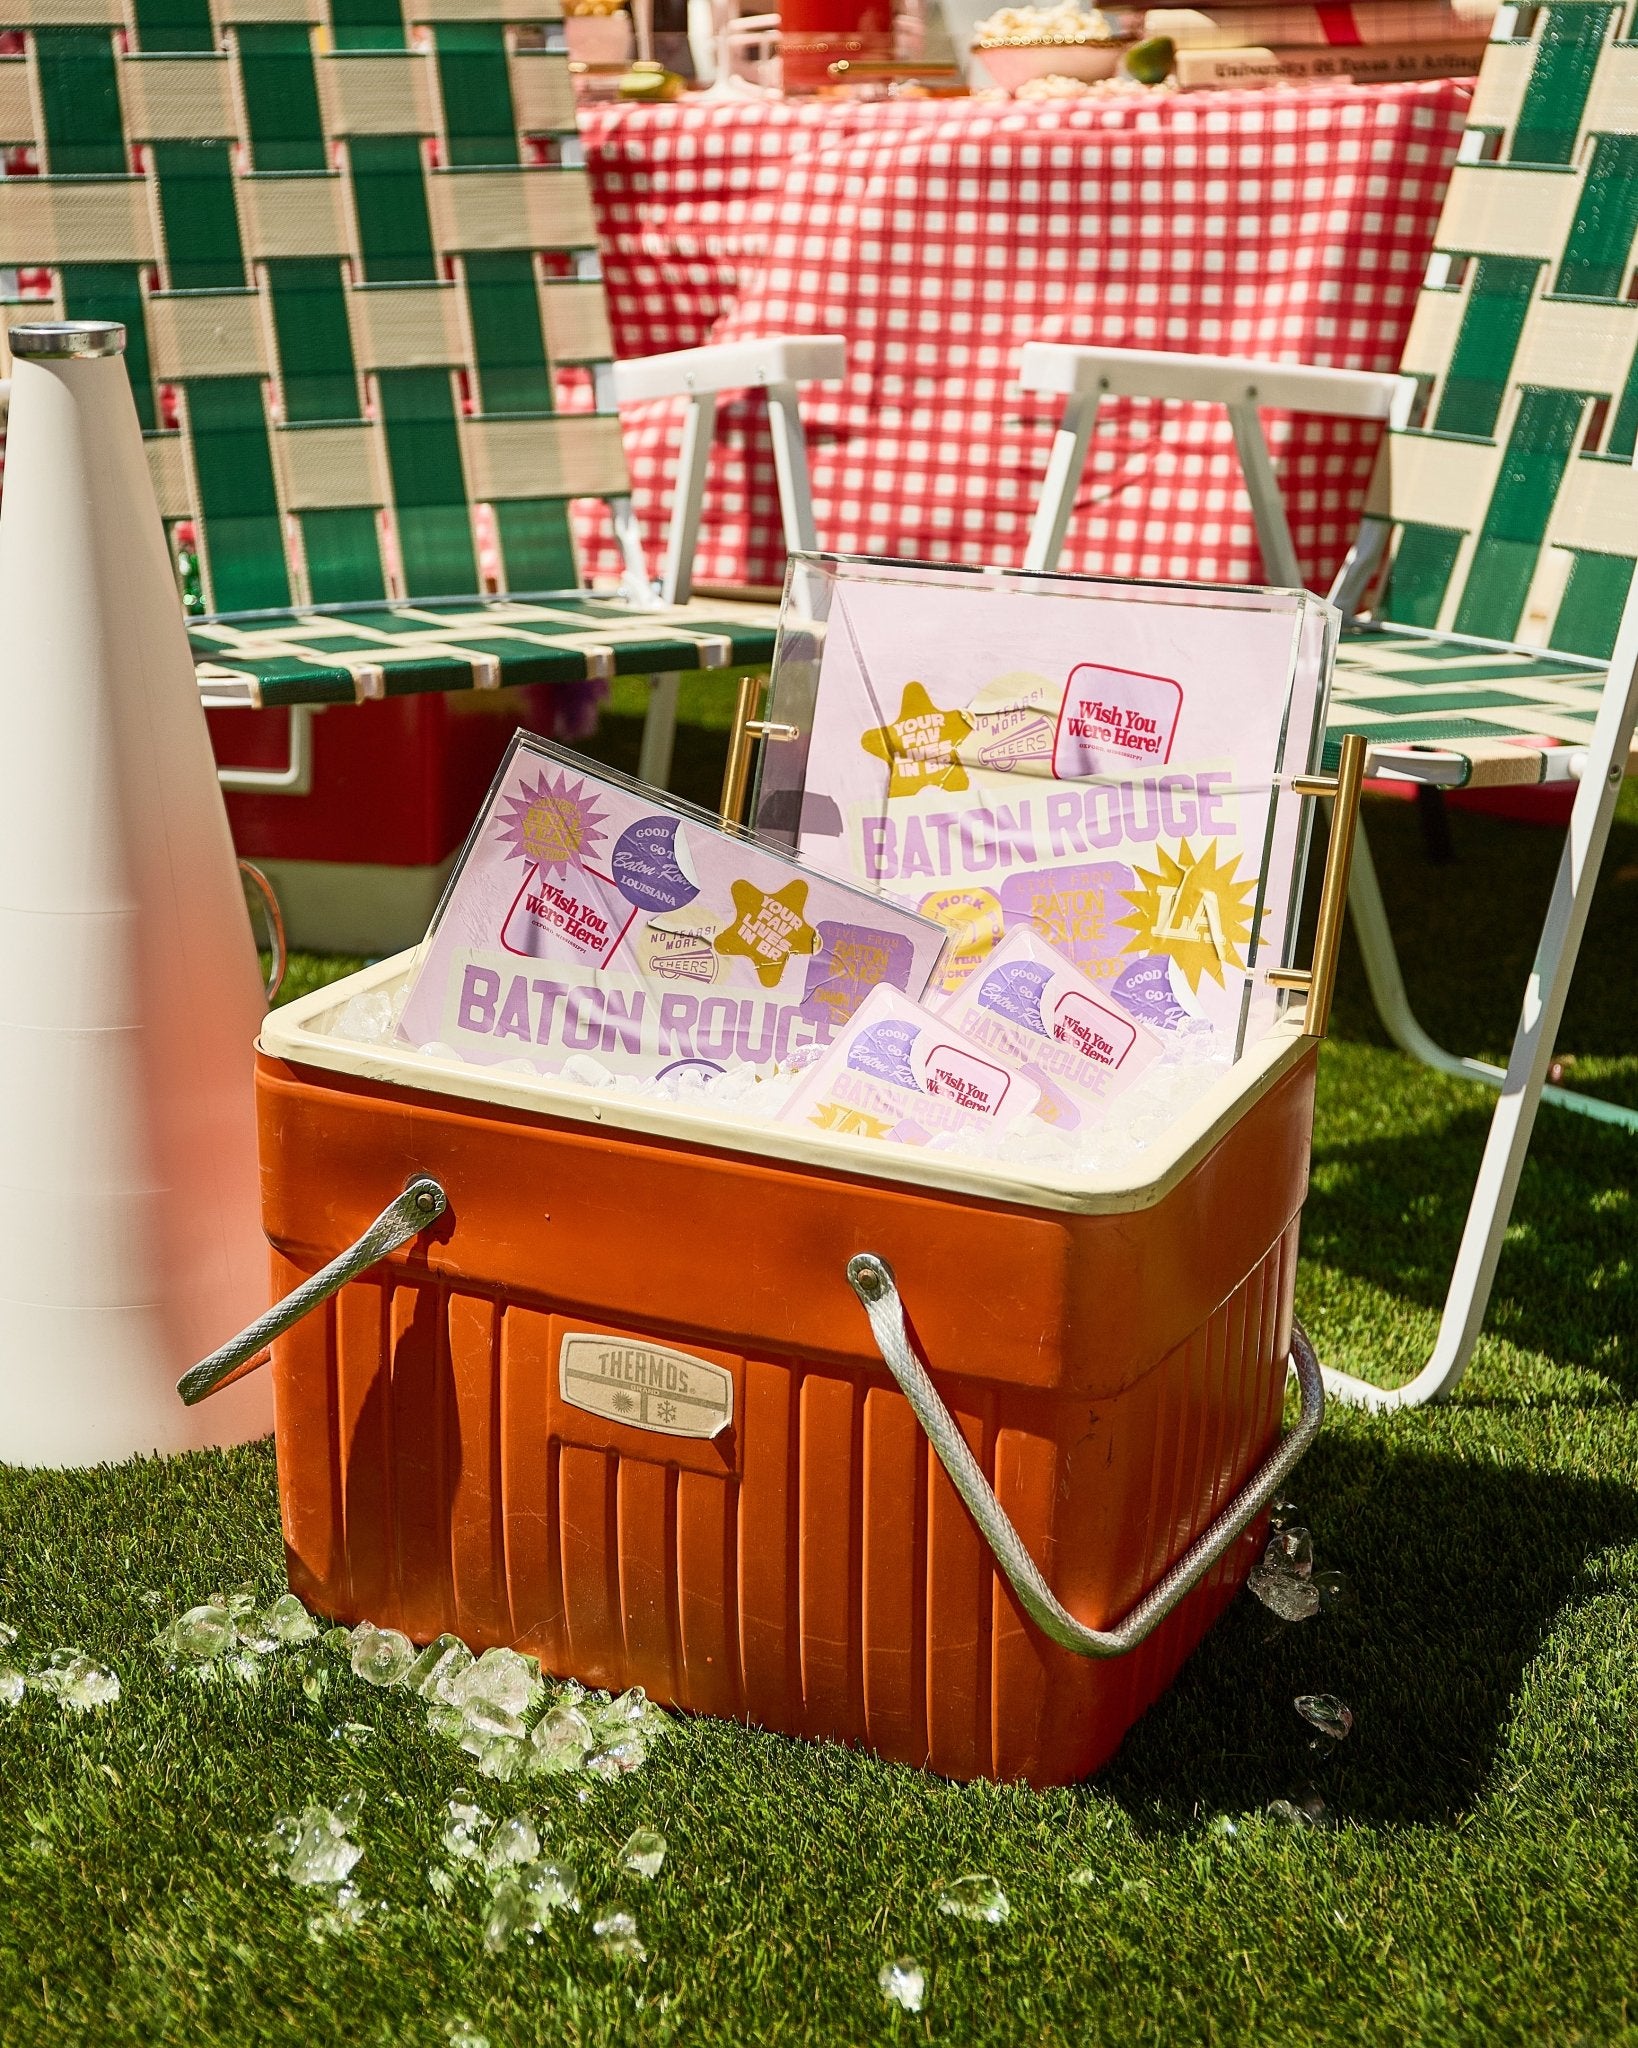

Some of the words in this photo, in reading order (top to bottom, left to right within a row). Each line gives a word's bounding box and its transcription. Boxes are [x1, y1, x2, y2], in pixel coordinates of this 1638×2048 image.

[893, 713, 946, 737] YOUR
[991, 710, 1027, 736] MORE
[1079, 700, 1123, 727] Wish
[1125, 710, 1157, 734] You
[901, 728, 940, 749] FAV
[989, 733, 1047, 759] CHEERS
[1067, 717, 1112, 743] Were
[1112, 727, 1163, 754] Here!
[894, 739, 952, 764] LIVES
[899, 762, 921, 777] IN
[924, 753, 951, 774] BR
[635, 827, 670, 839] GOOD
[862, 799, 1038, 880] BATON
[1047, 771, 1238, 857] ROUGE
[612, 850, 656, 877] Baton
[650, 843, 666, 856] GO
[620, 874, 677, 907] LOUISIANA
[937, 895, 985, 910] WORK
[1032, 889, 1105, 919] BATON
[524, 893, 565, 928] Were
[562, 916, 610, 952] Here!
[540, 881, 580, 916] Wish
[577, 904, 609, 935] You
[756, 908, 794, 937] FAV
[761, 894, 803, 932] YOUR
[1151, 885, 1227, 955] LA
[650, 932, 667, 943] NO
[665, 939, 698, 951] MORE
[736, 923, 758, 946] IN
[755, 940, 784, 962] BR
[742, 912, 793, 952] LIVES
[658, 960, 710, 975] CHEERS
[833, 938, 891, 969] BATON
[1010, 967, 1043, 986] GOOD
[1125, 969, 1163, 989] GOOD
[980, 982, 1019, 1014] Baton
[1018, 985, 1033, 999] GO
[1145, 989, 1164, 1001] GO
[457, 963, 646, 1055] BATON
[876, 1028, 909, 1042] GOOD
[886, 1044, 903, 1056] GO
[1053, 1024, 1081, 1051] Were
[1080, 1041, 1115, 1067] Here!
[1063, 1014, 1092, 1042] Wish
[1091, 1032, 1114, 1056] You
[849, 1043, 889, 1074] Baton
[960, 1007, 1031, 1063] BATON
[1034, 1040, 1114, 1098] ROUGE
[832, 1071, 906, 1120] BATON
[935, 1068, 966, 1092] Wish
[966, 1082, 989, 1102] You
[598, 1350, 690, 1393] THERMOS
